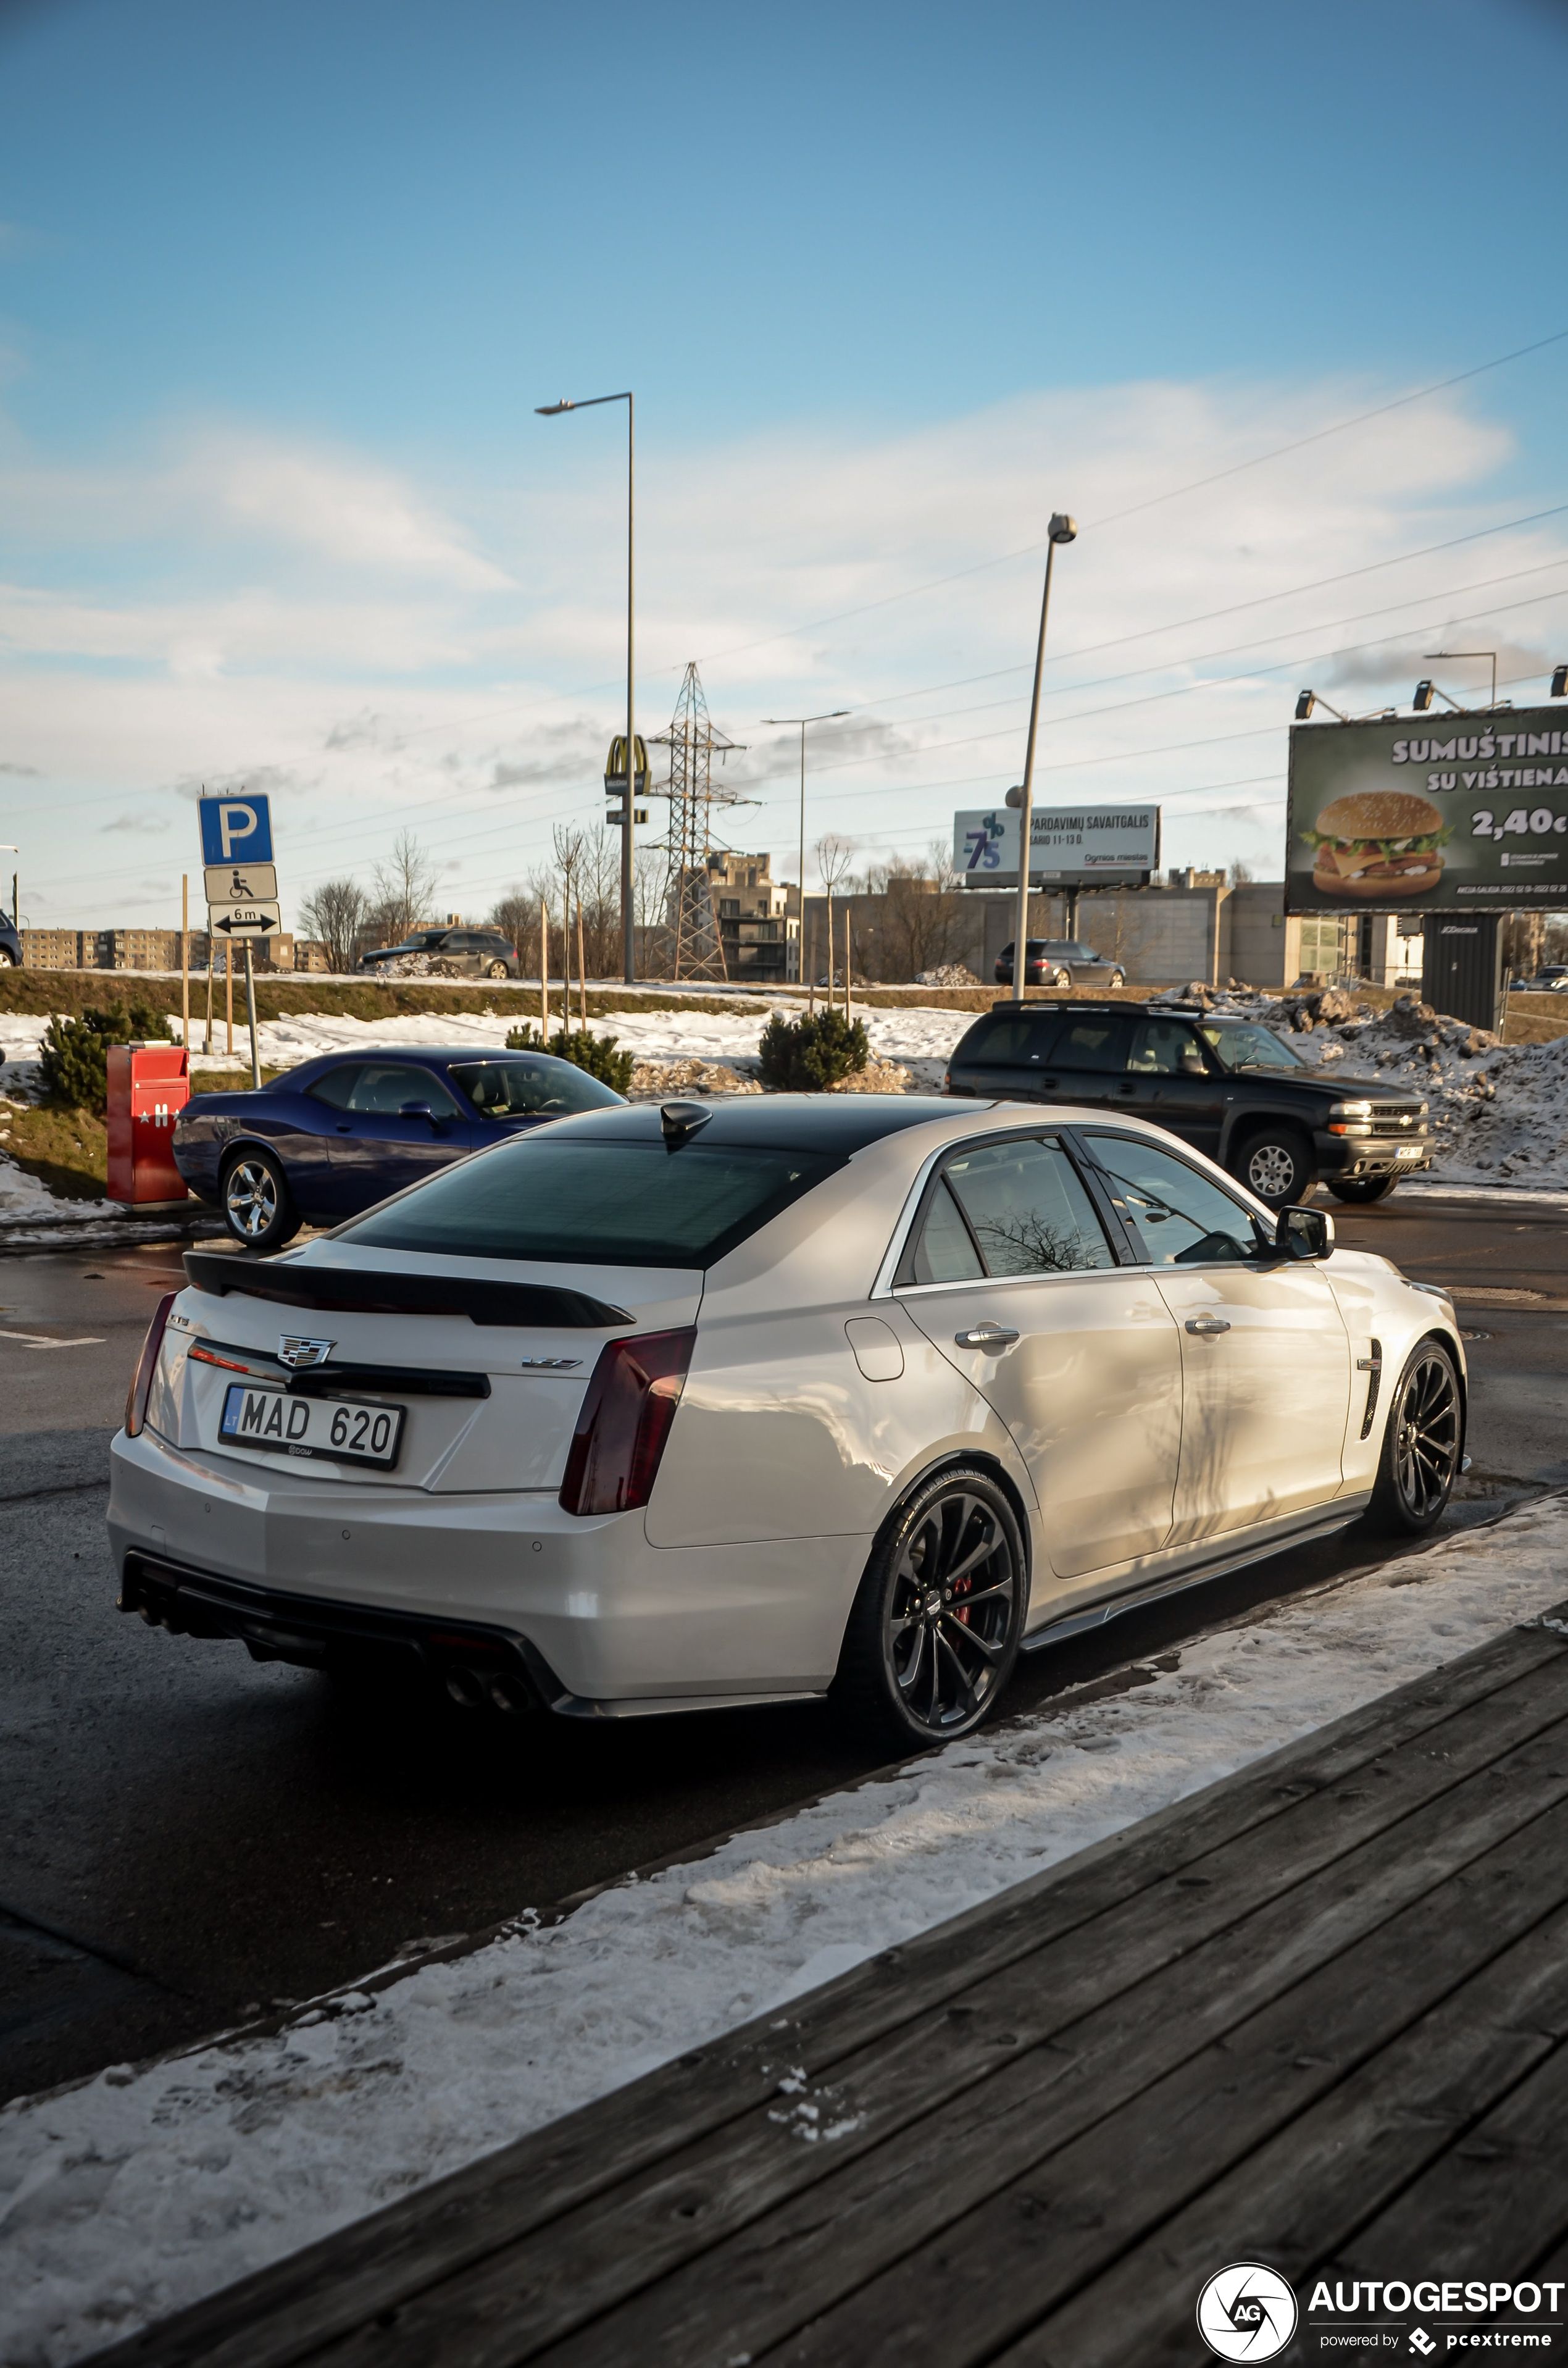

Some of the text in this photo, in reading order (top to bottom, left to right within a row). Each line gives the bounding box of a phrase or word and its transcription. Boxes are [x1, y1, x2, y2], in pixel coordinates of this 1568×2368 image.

[1427, 763, 1568, 791] SU VIŠTIENA
[219, 803, 257, 858] P
[1020, 815, 1149, 832] PARDAVIMŲ SAVAITGALIS
[1472, 808, 1567, 841] 2,40€
[1030, 835, 1050, 845] SARIO
[1053, 834, 1075, 844] 11-13
[1085, 854, 1115, 863] Ogmios
[235, 909, 256, 919] 6 m
[1441, 926, 1478, 934] JCDecaux
[155, 1103, 168, 1128] H
[225, 1415, 237, 1426] LT
[242, 1393, 391, 1452] MAD 620
